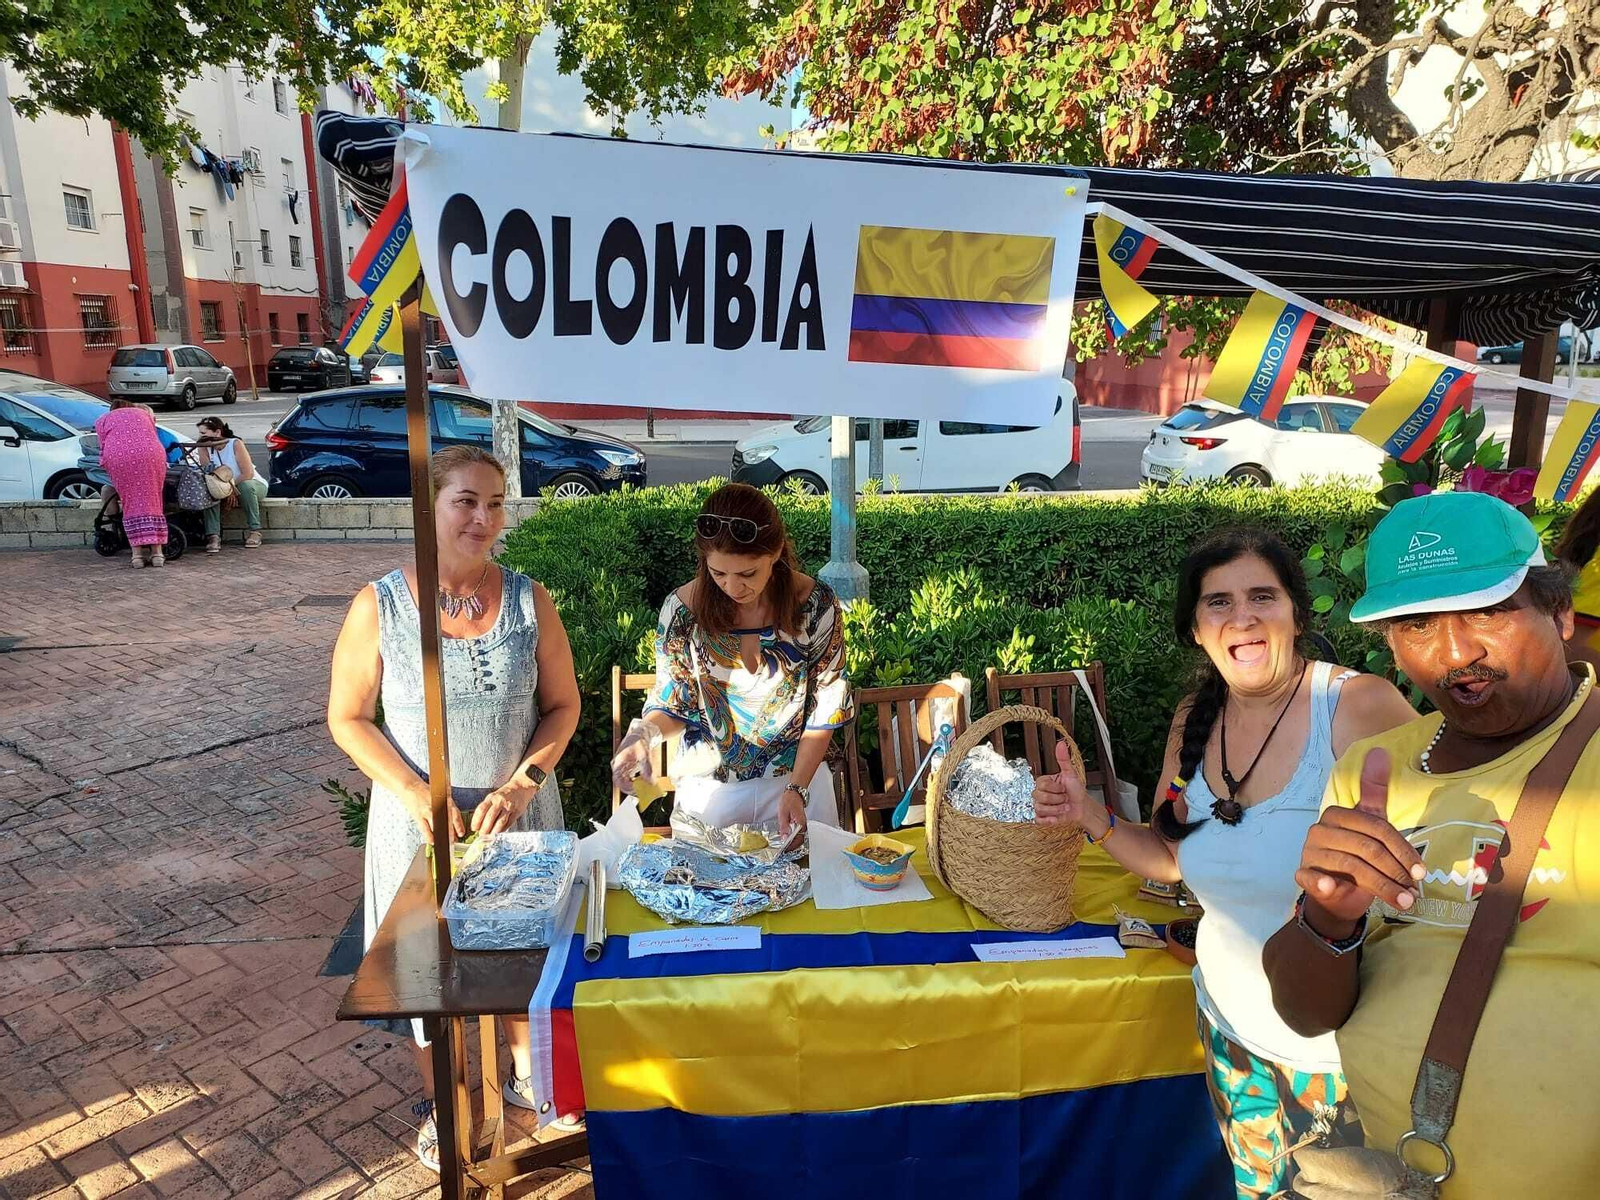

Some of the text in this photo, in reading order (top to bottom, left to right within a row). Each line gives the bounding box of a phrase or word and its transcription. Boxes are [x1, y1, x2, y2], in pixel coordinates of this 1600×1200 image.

[367, 211, 412, 282] LOMBIA
[438, 193, 826, 350] COLOMBIA
[1398, 547, 1455, 564] LAS DUNAS
